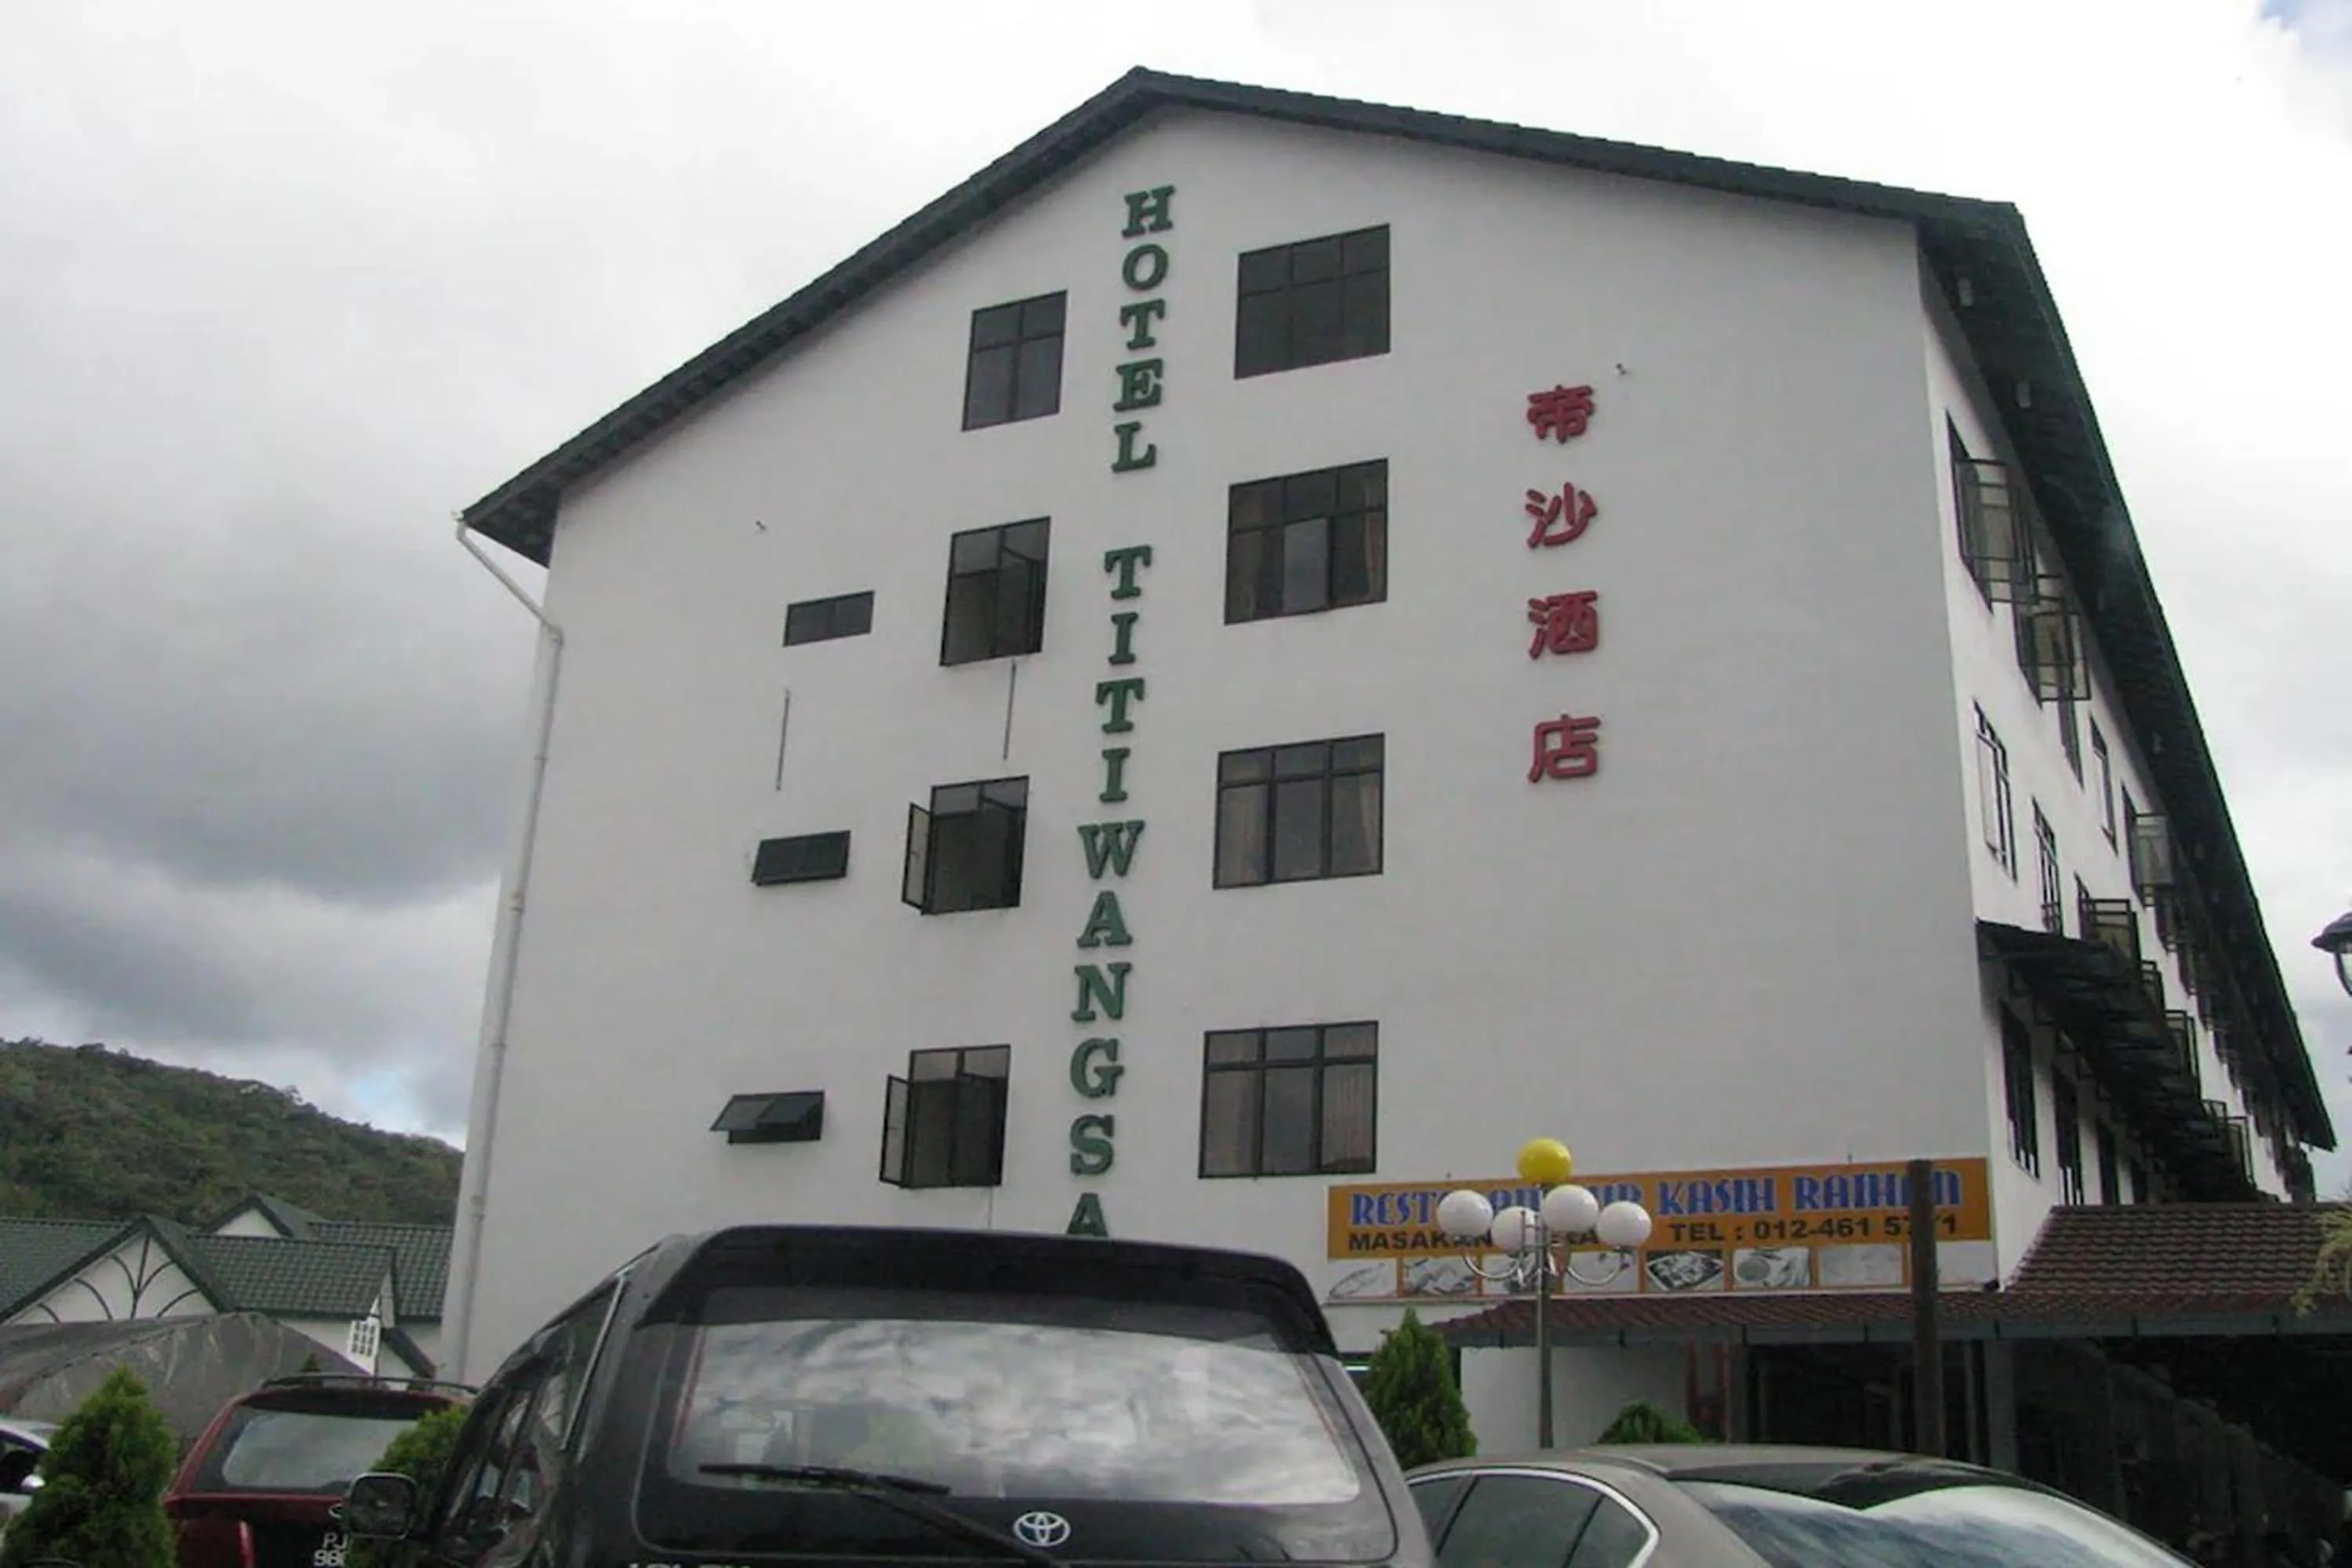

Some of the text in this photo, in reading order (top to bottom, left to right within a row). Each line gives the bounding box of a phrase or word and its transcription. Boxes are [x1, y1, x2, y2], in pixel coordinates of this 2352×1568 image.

[1066, 185, 1177, 1236] HOTEL TITIWANGSA
[1525, 384, 1602, 783] 帝沙酒店
[1669, 1221, 1725, 1242] TEL
[1753, 1217, 1871, 1240] 012-461
